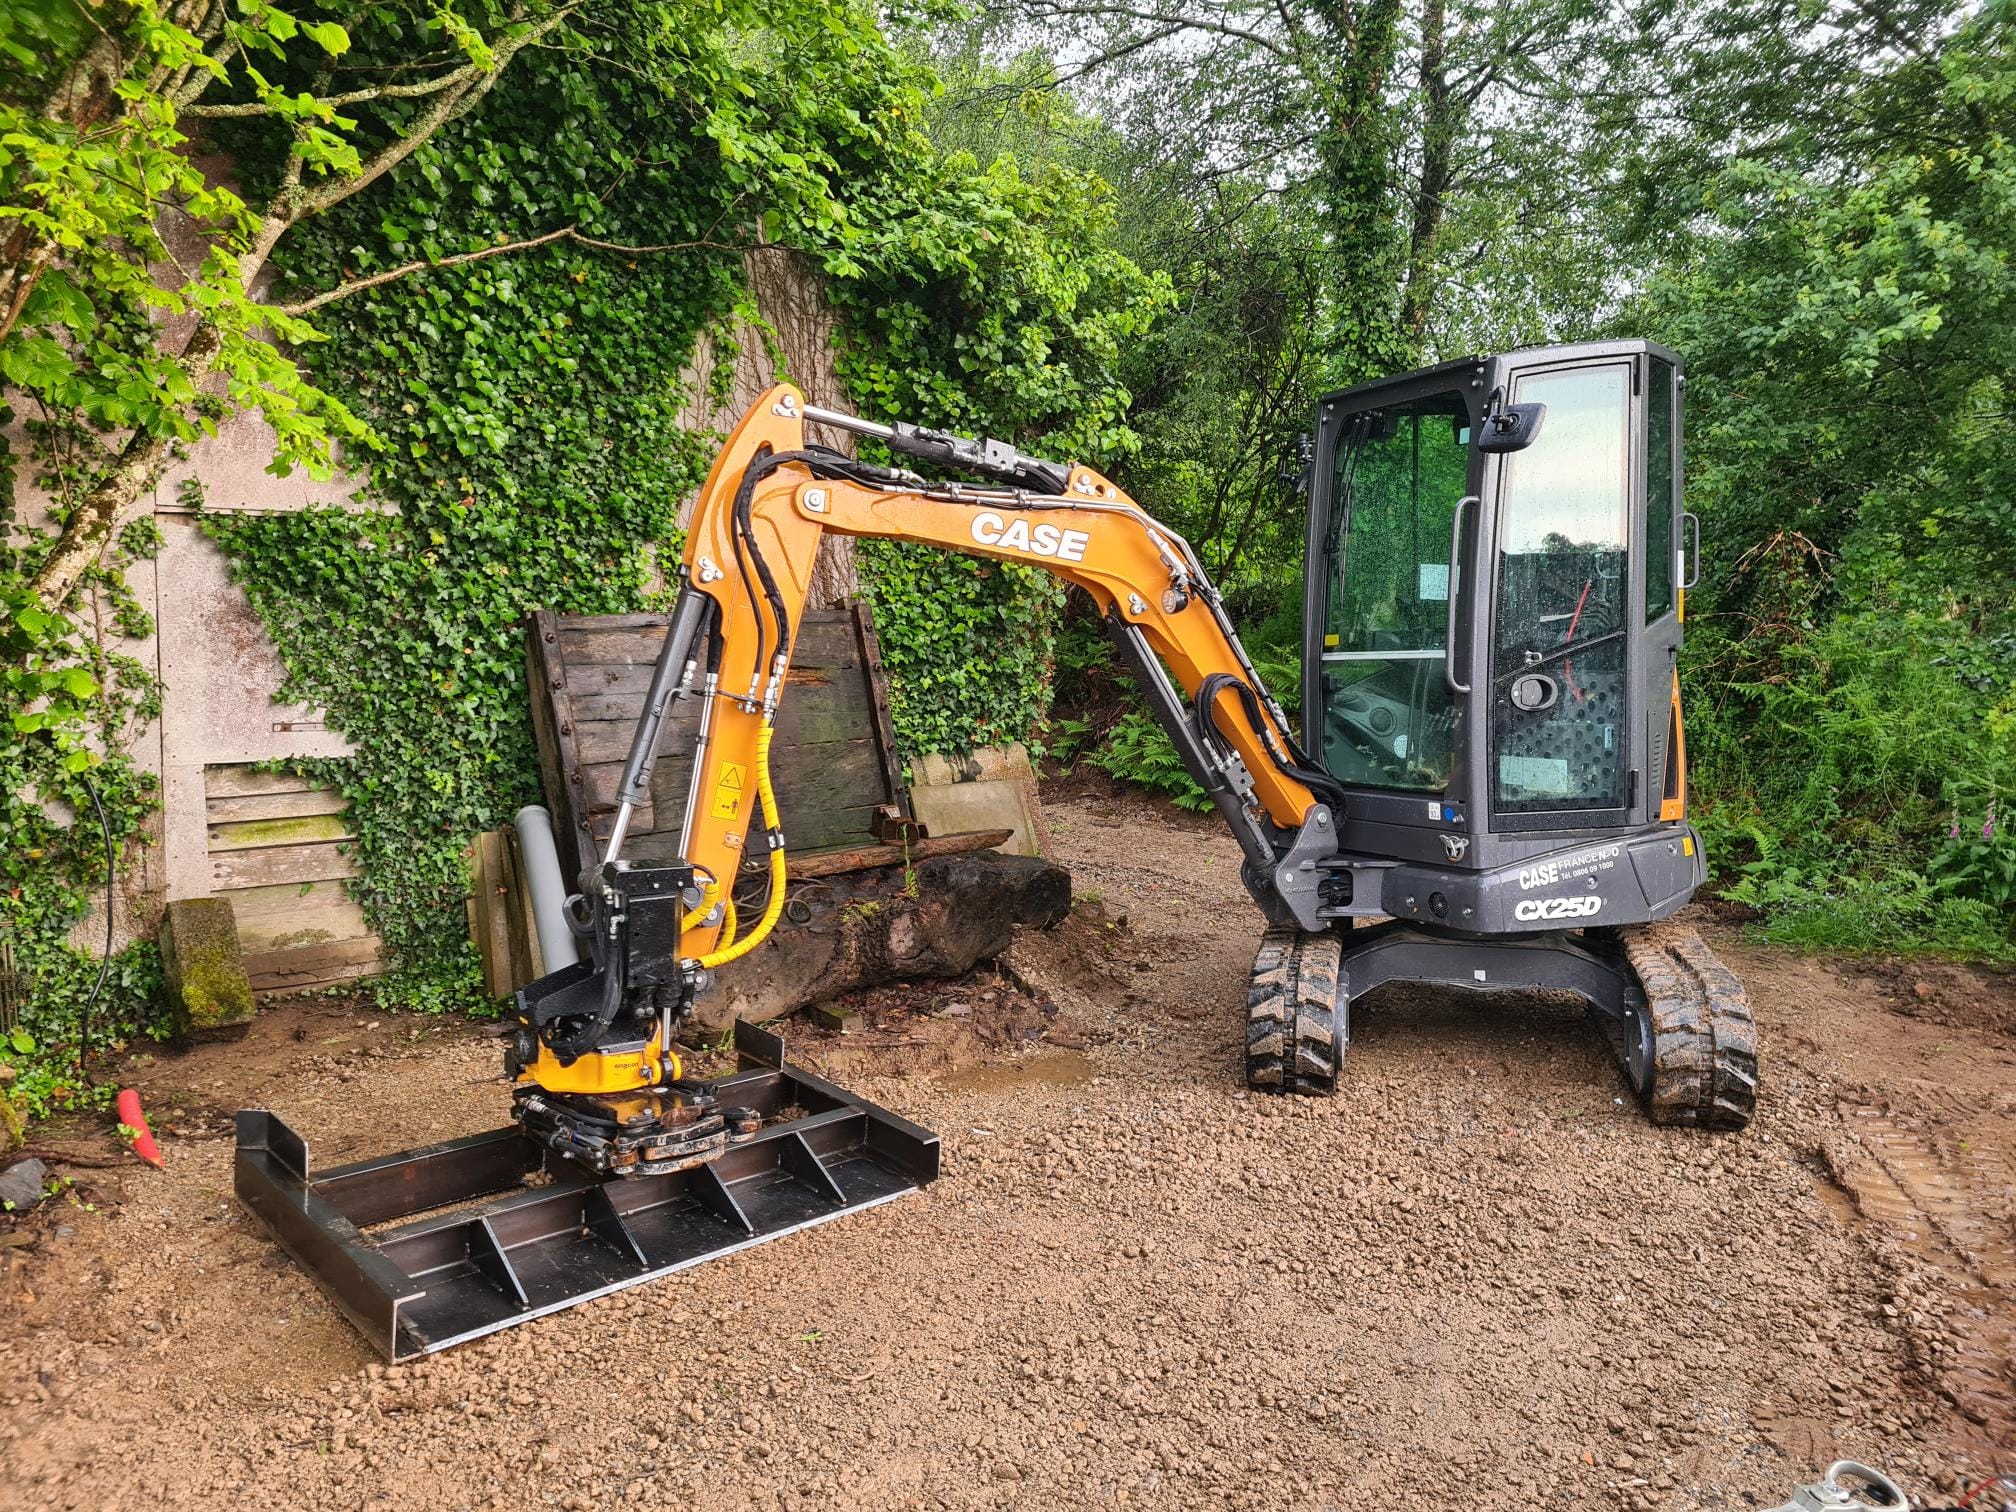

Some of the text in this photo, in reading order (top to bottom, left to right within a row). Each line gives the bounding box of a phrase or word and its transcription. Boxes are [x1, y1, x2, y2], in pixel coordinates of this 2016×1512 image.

[971, 512, 1090, 562] CASE
[1519, 863, 1559, 890] CASE
[1573, 867, 1589, 878] 0806
[1589, 865, 1598, 873] 09
[1598, 860, 1614, 870] 1000
[1514, 896, 1602, 921] CX25D
